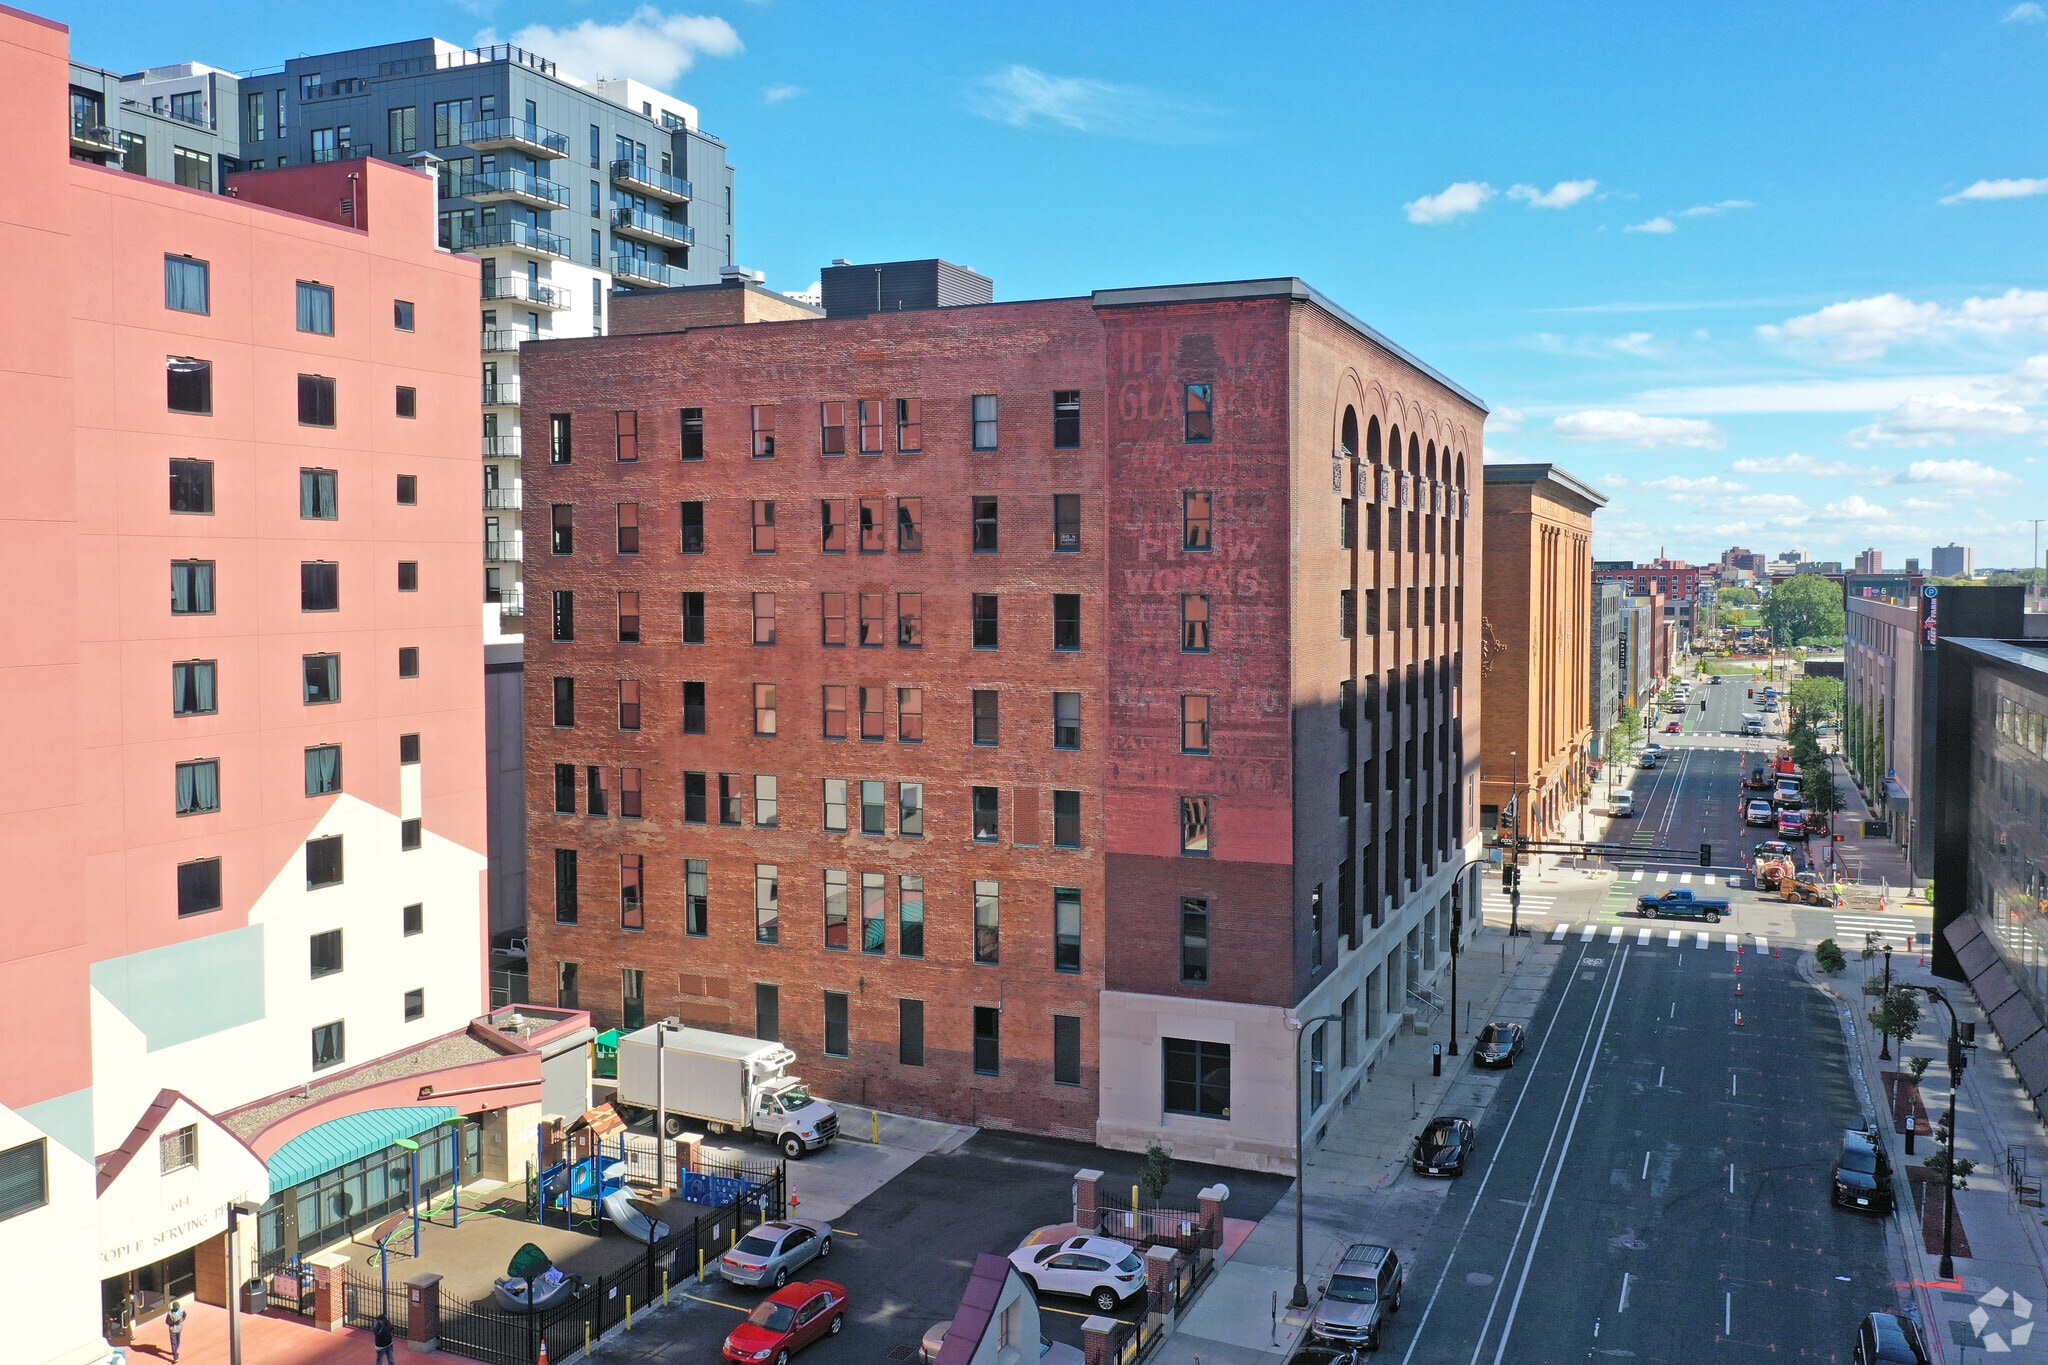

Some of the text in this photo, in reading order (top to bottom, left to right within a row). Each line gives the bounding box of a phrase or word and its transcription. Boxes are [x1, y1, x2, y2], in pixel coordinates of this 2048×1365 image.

[1137, 536, 1262, 562] PLW
[153, 1213, 208, 1247] SERVING
[214, 1189, 250, 1220] PEPLE
